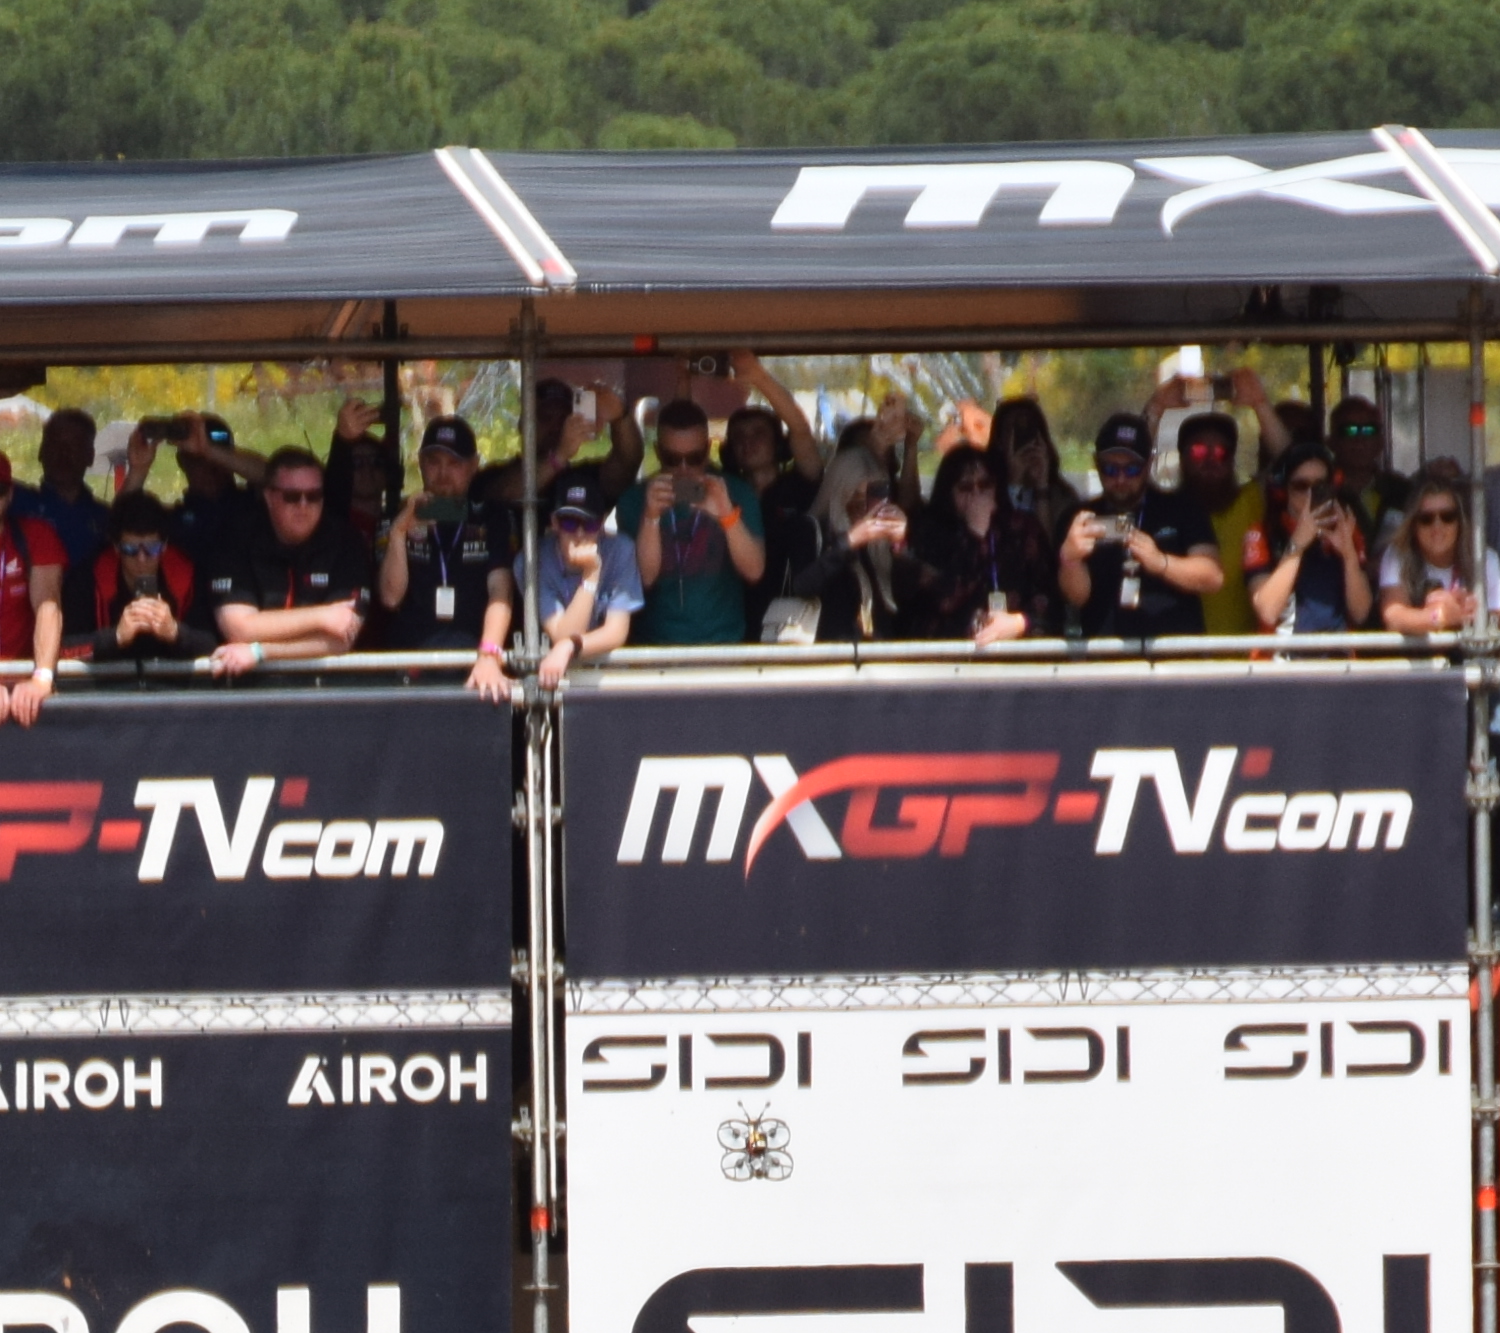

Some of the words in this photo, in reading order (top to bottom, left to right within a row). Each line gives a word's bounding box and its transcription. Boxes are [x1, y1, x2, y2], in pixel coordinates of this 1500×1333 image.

[286, 1053, 489, 1107] AIROH
[581, 1031, 812, 1093] SIDI
[901, 1026, 1132, 1088] SIDI
[1223, 1019, 1454, 1081] SIDI
